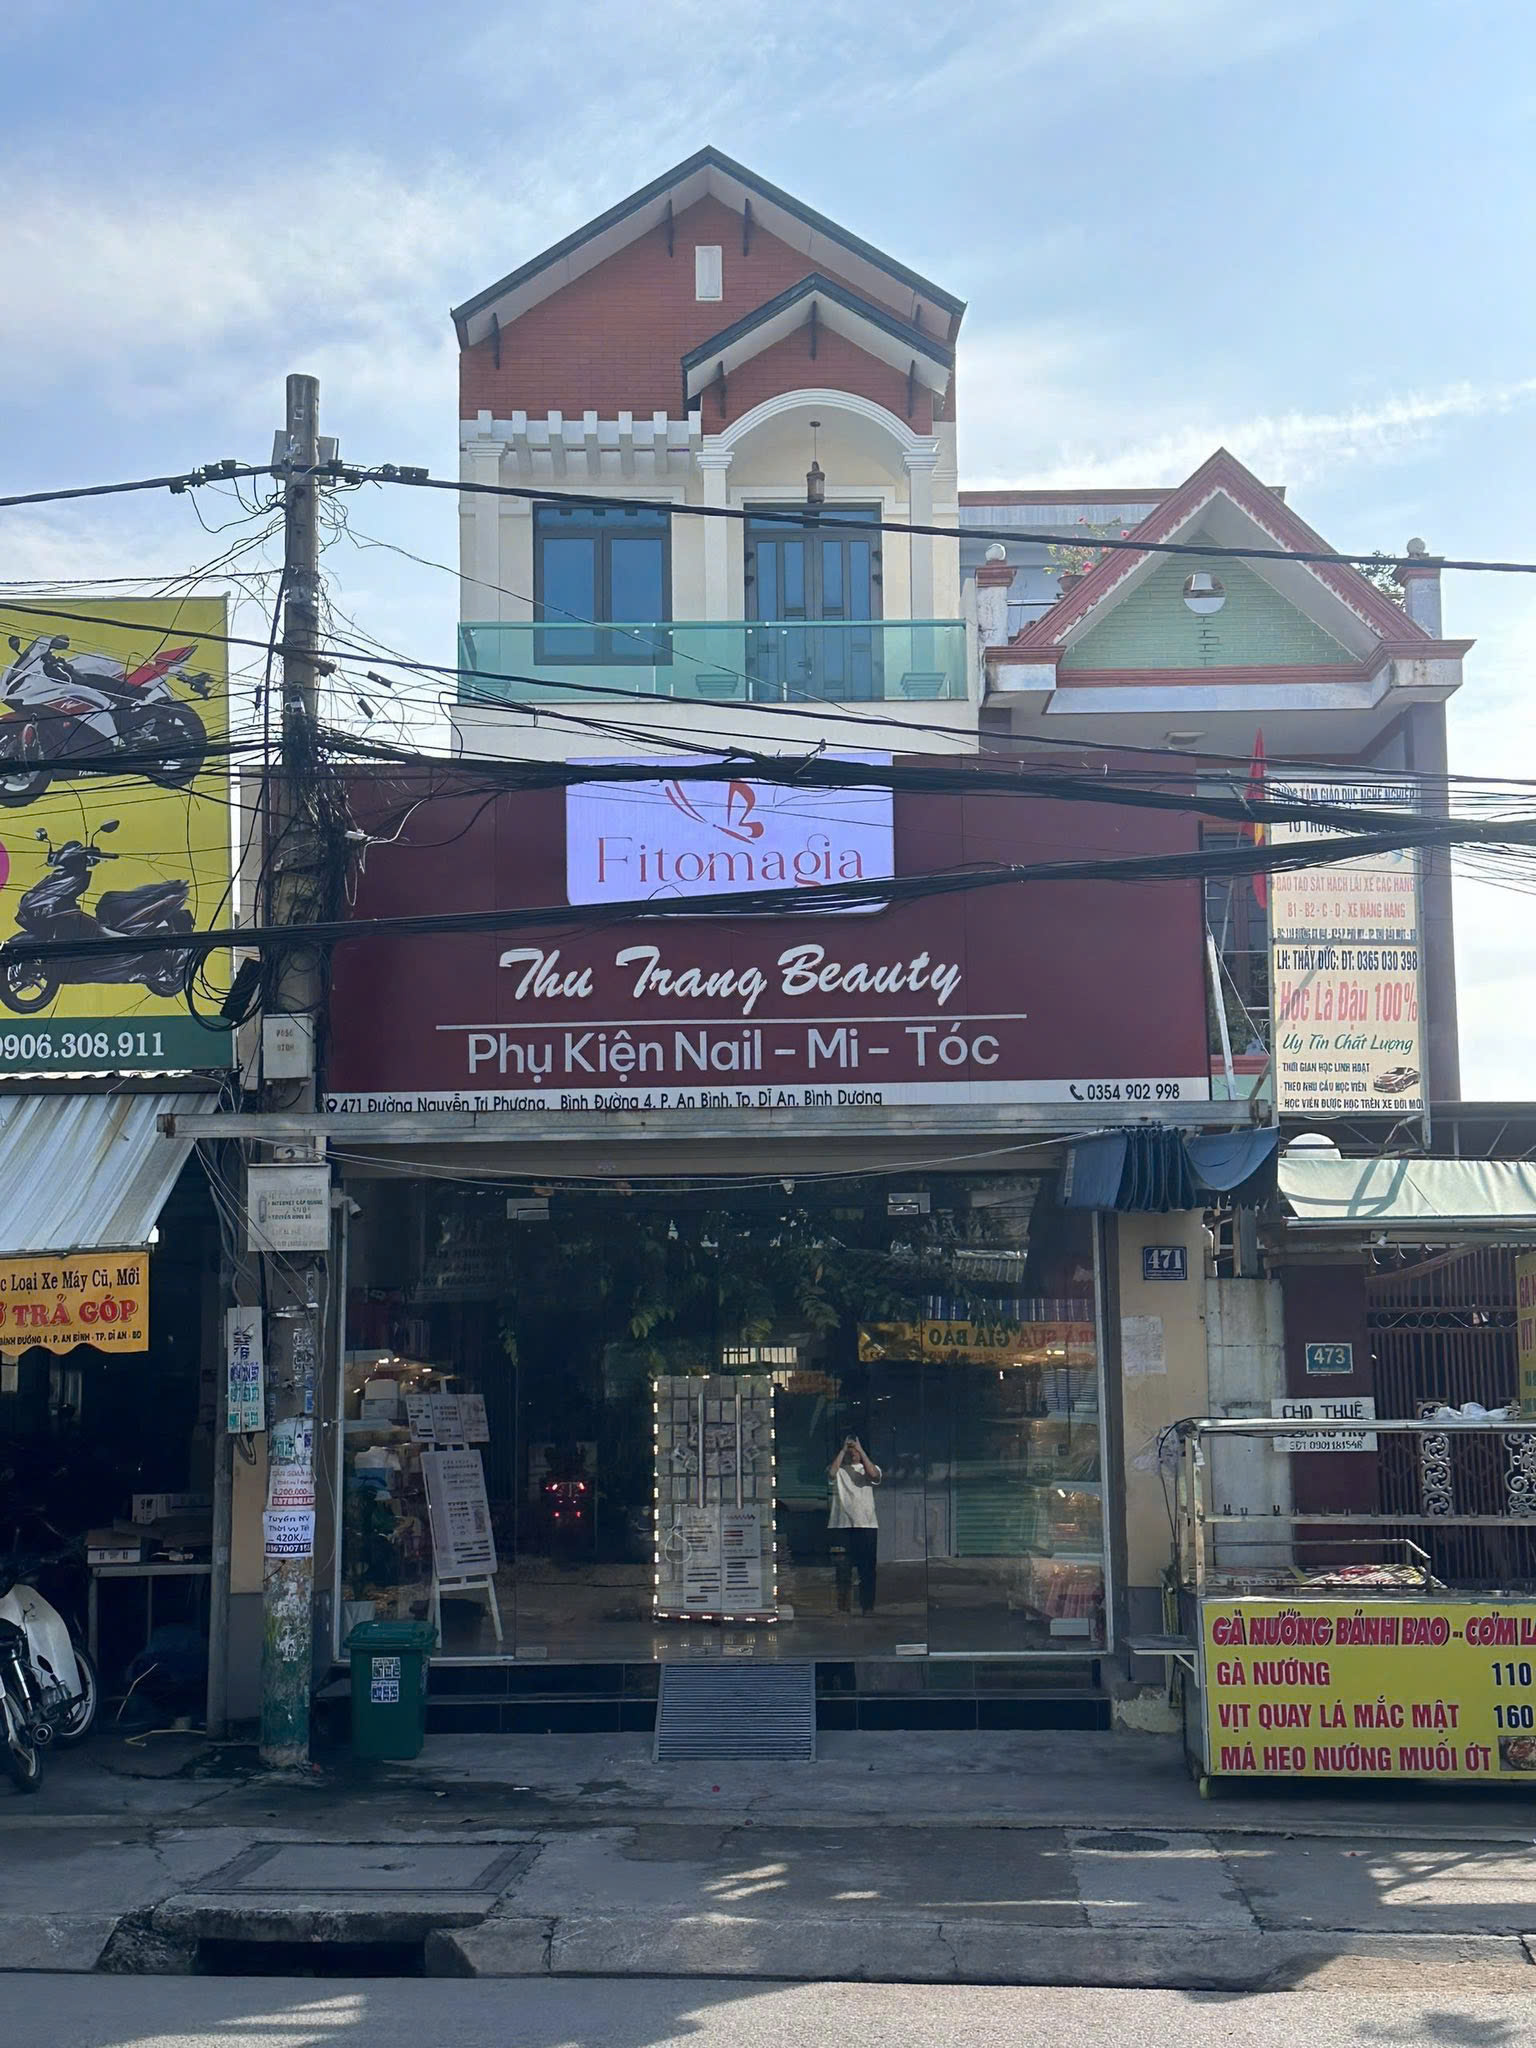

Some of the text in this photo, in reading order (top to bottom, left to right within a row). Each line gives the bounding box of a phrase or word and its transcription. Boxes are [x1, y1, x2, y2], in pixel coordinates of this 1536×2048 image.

[597, 834, 864, 887] Fitomagia
[1288, 902, 1297, 918] B1
[1277, 950, 1291, 970] LH:
[1357, 951, 1379, 970] 0365
[1381, 951, 1398, 970] 030
[1401, 951, 1418, 971] 398
[499, 943, 962, 1015] Thu Trang Beauty
[1280, 981, 1310, 1030] Học
[1315, 980, 1334, 1021] Là
[1375, 982, 1418, 1022] 100%
[0, 1032, 165, 1060] 906.308.911
[467, 1031, 553, 1084] Phụ
[565, 1030, 665, 1083] Kiện
[675, 1028, 763, 1073] Nail
[809, 1027, 860, 1071] Mi
[905, 1022, 1000, 1066] Tóc
[1283, 1033, 1303, 1054] Uy
[1334, 1033, 1367, 1050] Chất
[1370, 1034, 1413, 1055] Lượng
[340, 1098, 361, 1113] 471
[367, 1096, 412, 1113] Đường
[417, 1093, 470, 1112] Nguyễn
[560, 1094, 588, 1110] Bình
[594, 1092, 639, 1109] Đường
[676, 1093, 695, 1108] An
[758, 1088, 772, 1107] Dĩ
[804, 1090, 833, 1106] Bình
[838, 1089, 883, 1106] Dương
[1087, 1083, 1180, 1101] 0354 902 998
[1382, 1098, 1393, 1109] XE
[1148, 1249, 1182, 1269] 471
[11, 1272, 38, 1295] Loại
[41, 1272, 58, 1289] Xe
[62, 1270, 88, 1293] Máy
[92, 1268, 113, 1289] Cũ,
[116, 1267, 140, 1286] Mới
[12, 1293, 73, 1328] TRẢ
[61, 1333, 72, 1343] AN
[96, 1332, 107, 1341] TP.
[117, 1331, 127, 1340] AN
[1313, 1347, 1345, 1364] 473
[1282, 1401, 1363, 1419] CHO THUÊ
[1212, 1609, 1247, 1646] GÀ
[1250, 1608, 1334, 1646] NƯỚNG
[1336, 1608, 1399, 1646] BÁNH
[1401, 1616, 1450, 1646] BAO
[1465, 1612, 1519, 1646] CƠM
[1520, 1617, 1536, 1646] L
[1216, 1656, 1533, 1686] GÀ NƯỚNG 110
[1218, 1694, 1534, 1734] VỊT QUAY LÁ MẮC MẬT 160
[1221, 1738, 1492, 1771] MÁ HEO NƯỚNG MUỐI ỚT
